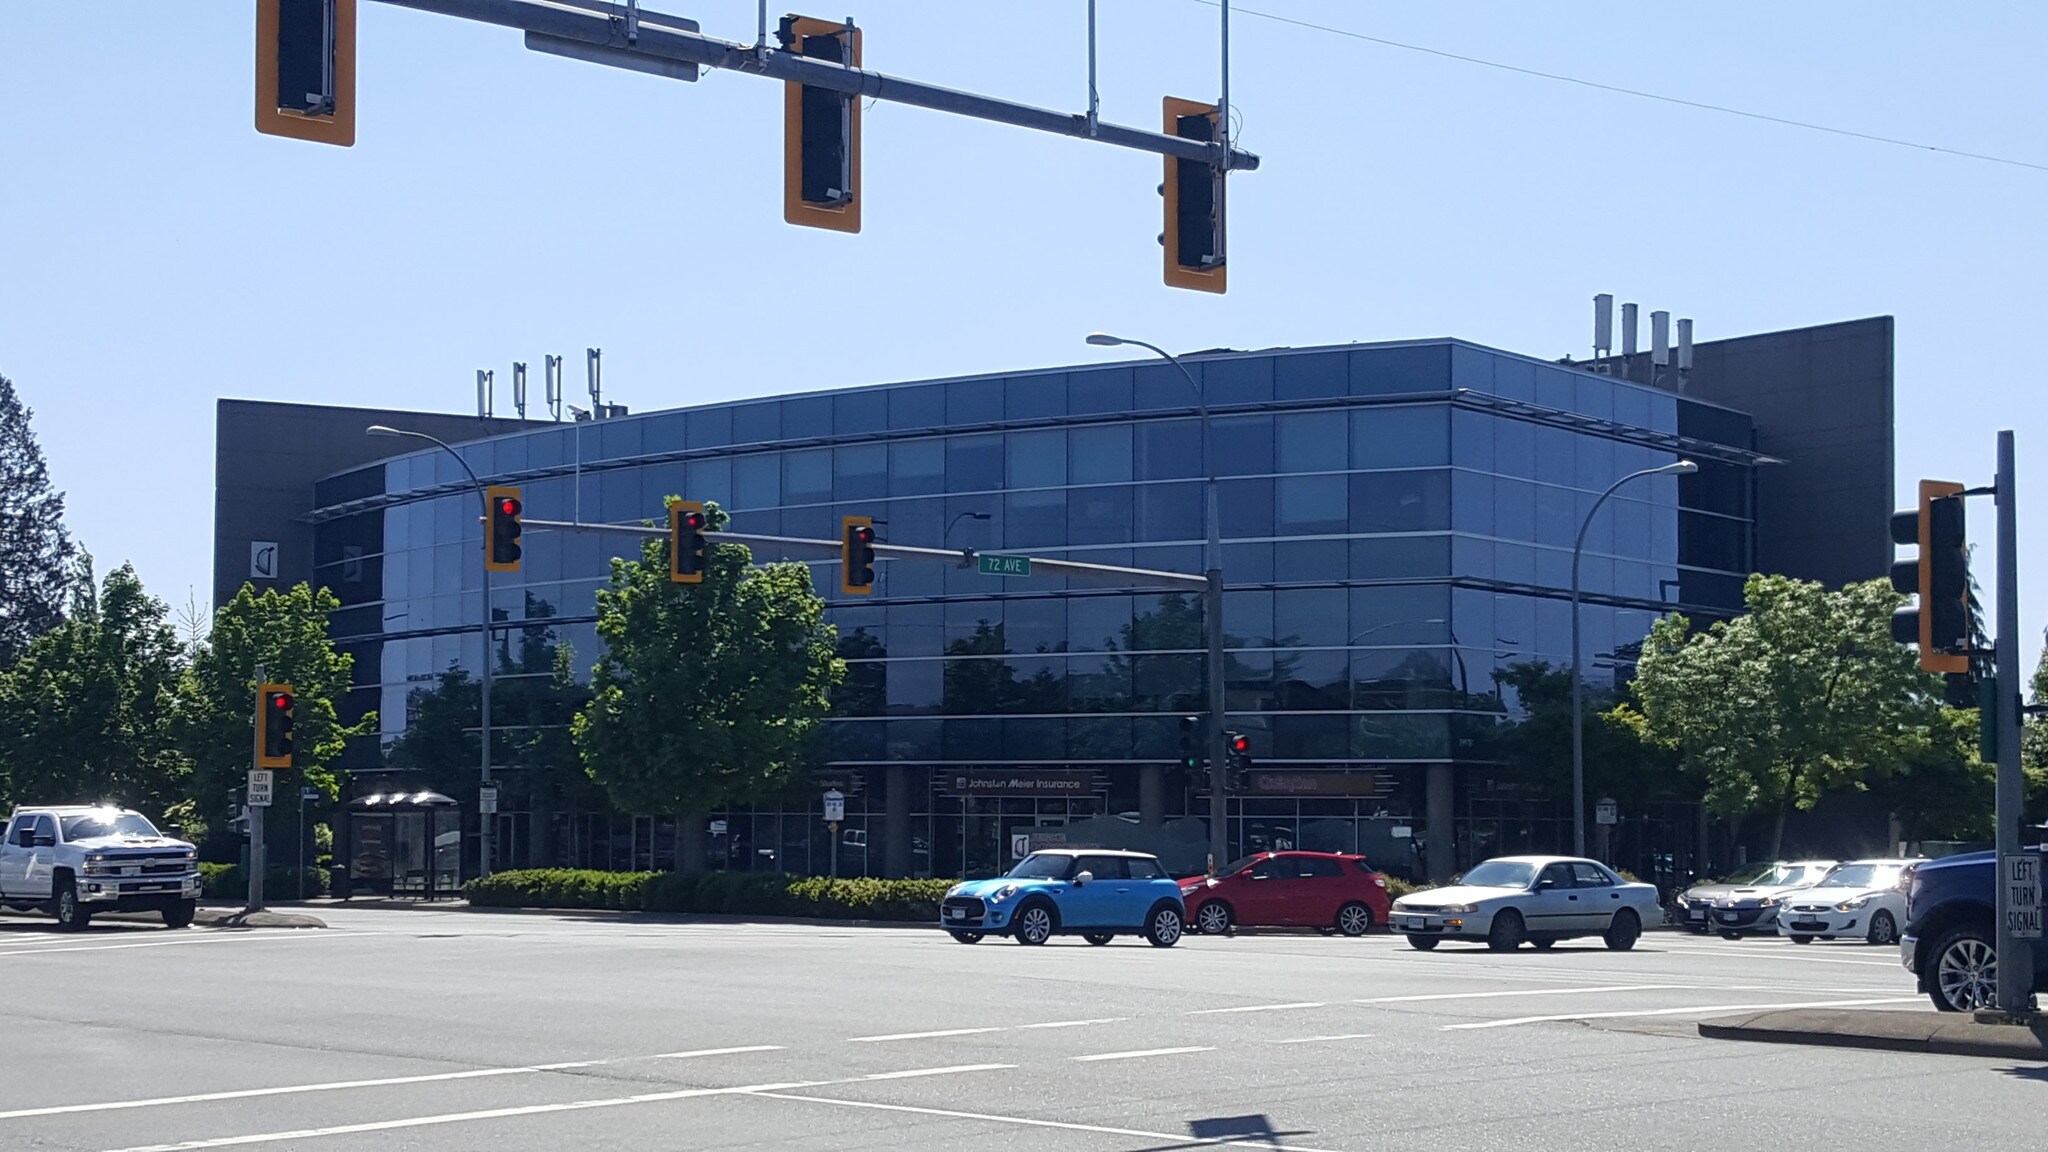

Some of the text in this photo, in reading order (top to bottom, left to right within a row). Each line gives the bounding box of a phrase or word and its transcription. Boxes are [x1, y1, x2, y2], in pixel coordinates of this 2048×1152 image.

[988, 558, 1022, 572] 72 AVE
[254, 773, 268, 782] LEFT
[253, 784, 268, 792] TURN
[1008, 779, 1034, 788] Meier
[1036, 779, 1080, 789] Insurance
[250, 794, 270, 803] SIGNAL
[2012, 861, 2032, 881] LEFT
[2011, 887, 2035, 905] TURN
[2008, 911, 2041, 931] SIGNAL
